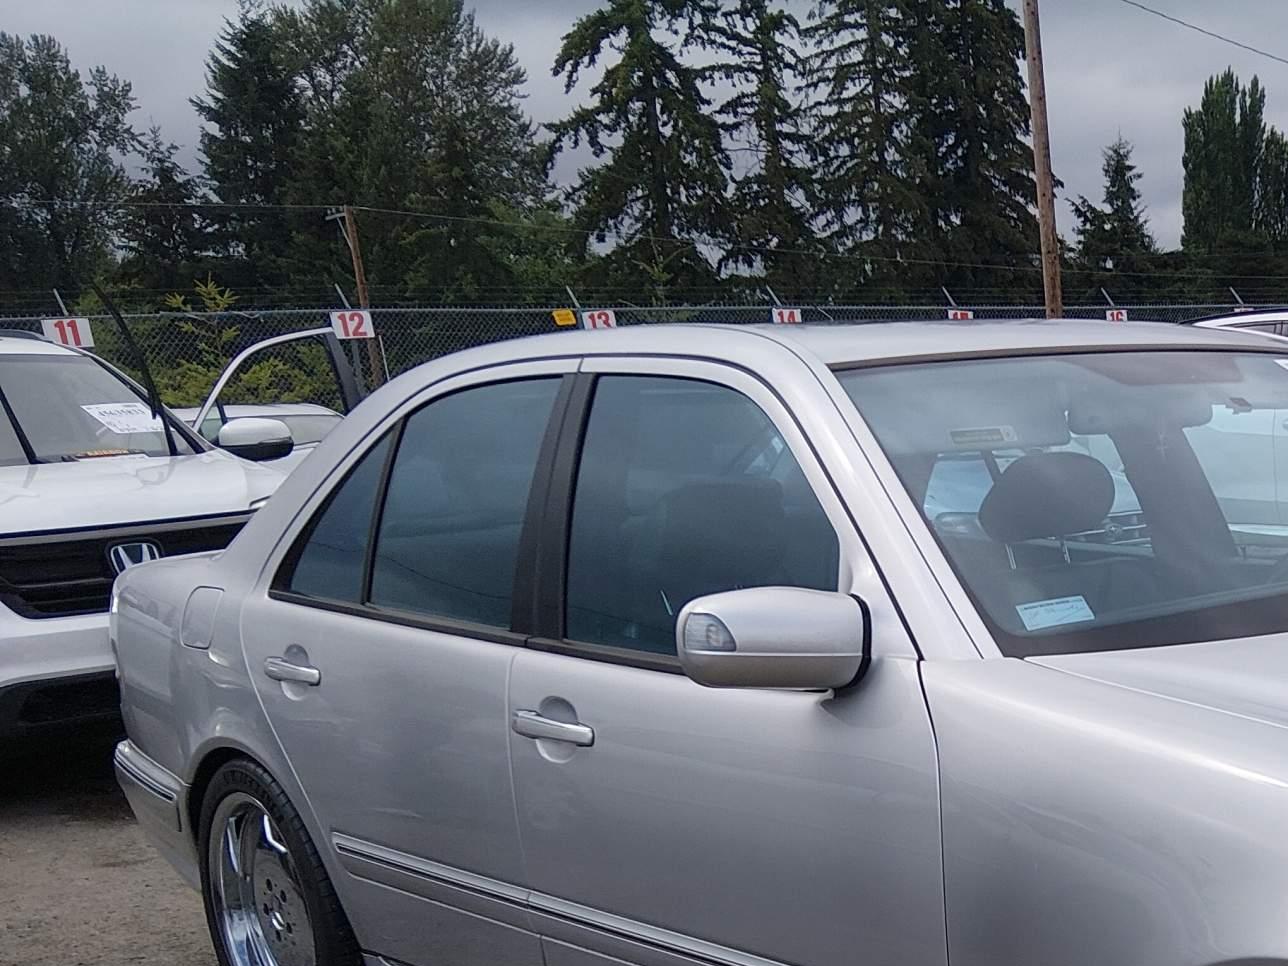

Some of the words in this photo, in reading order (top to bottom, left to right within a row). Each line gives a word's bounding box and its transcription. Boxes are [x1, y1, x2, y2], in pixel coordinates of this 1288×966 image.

[54, 319, 82, 346] 11
[337, 312, 368, 337] 12
[588, 311, 612, 329] 13
